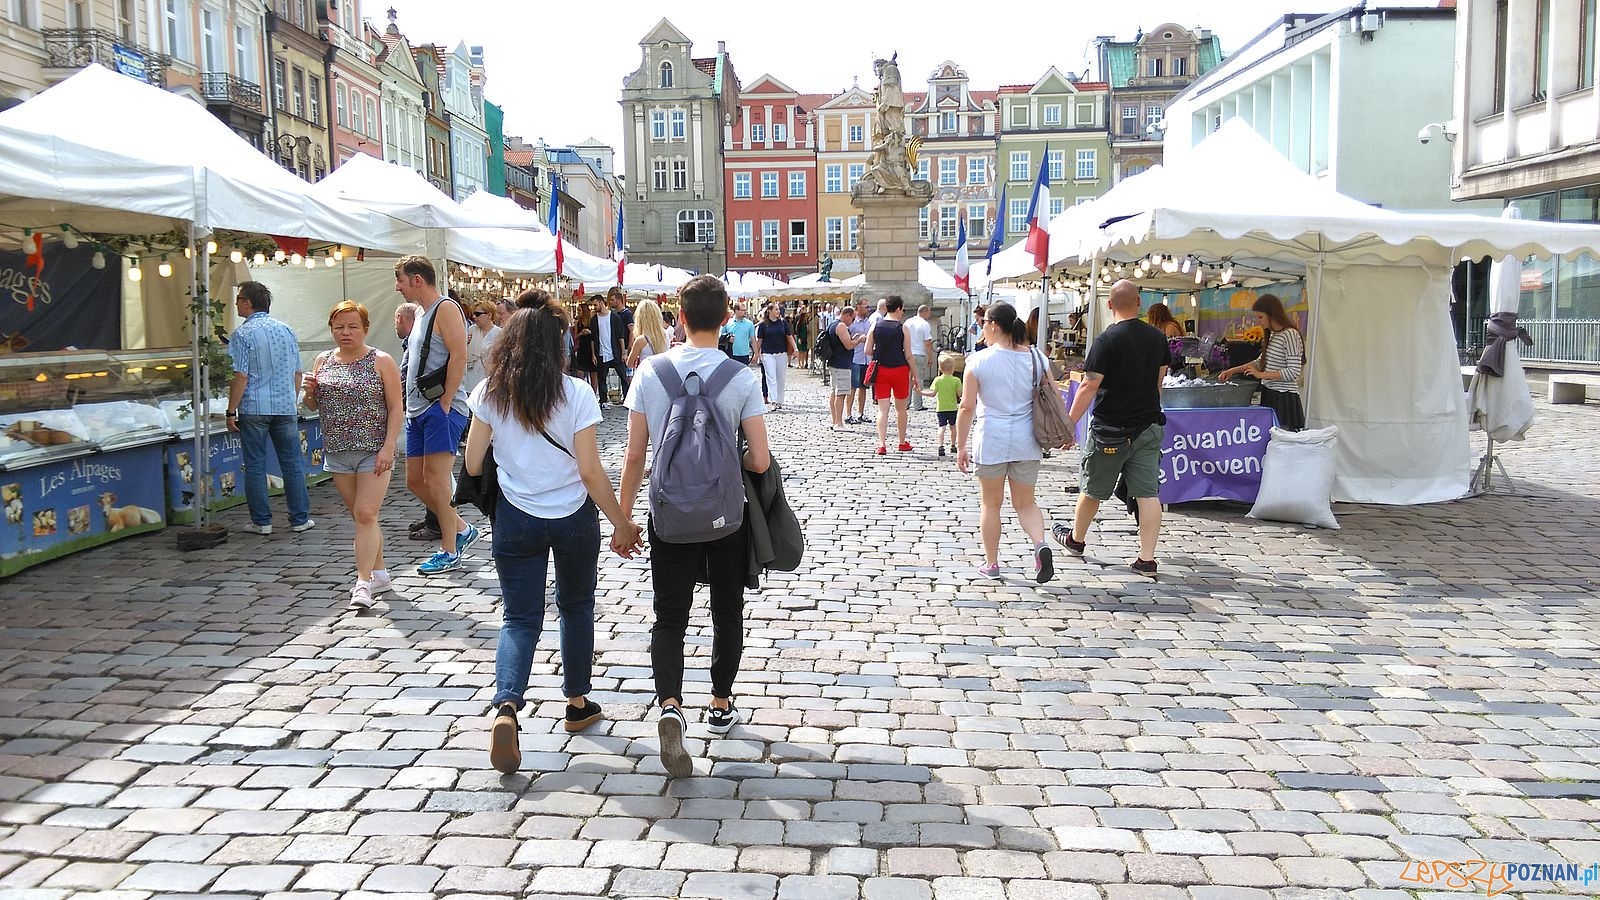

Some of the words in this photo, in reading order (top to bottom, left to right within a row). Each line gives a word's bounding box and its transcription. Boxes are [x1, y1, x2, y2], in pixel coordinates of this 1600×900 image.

[0, 268, 52, 305] ages
[40, 471, 66, 498] Les
[69, 458, 122, 485] Alpages
[1171, 453, 1264, 481] Proven
